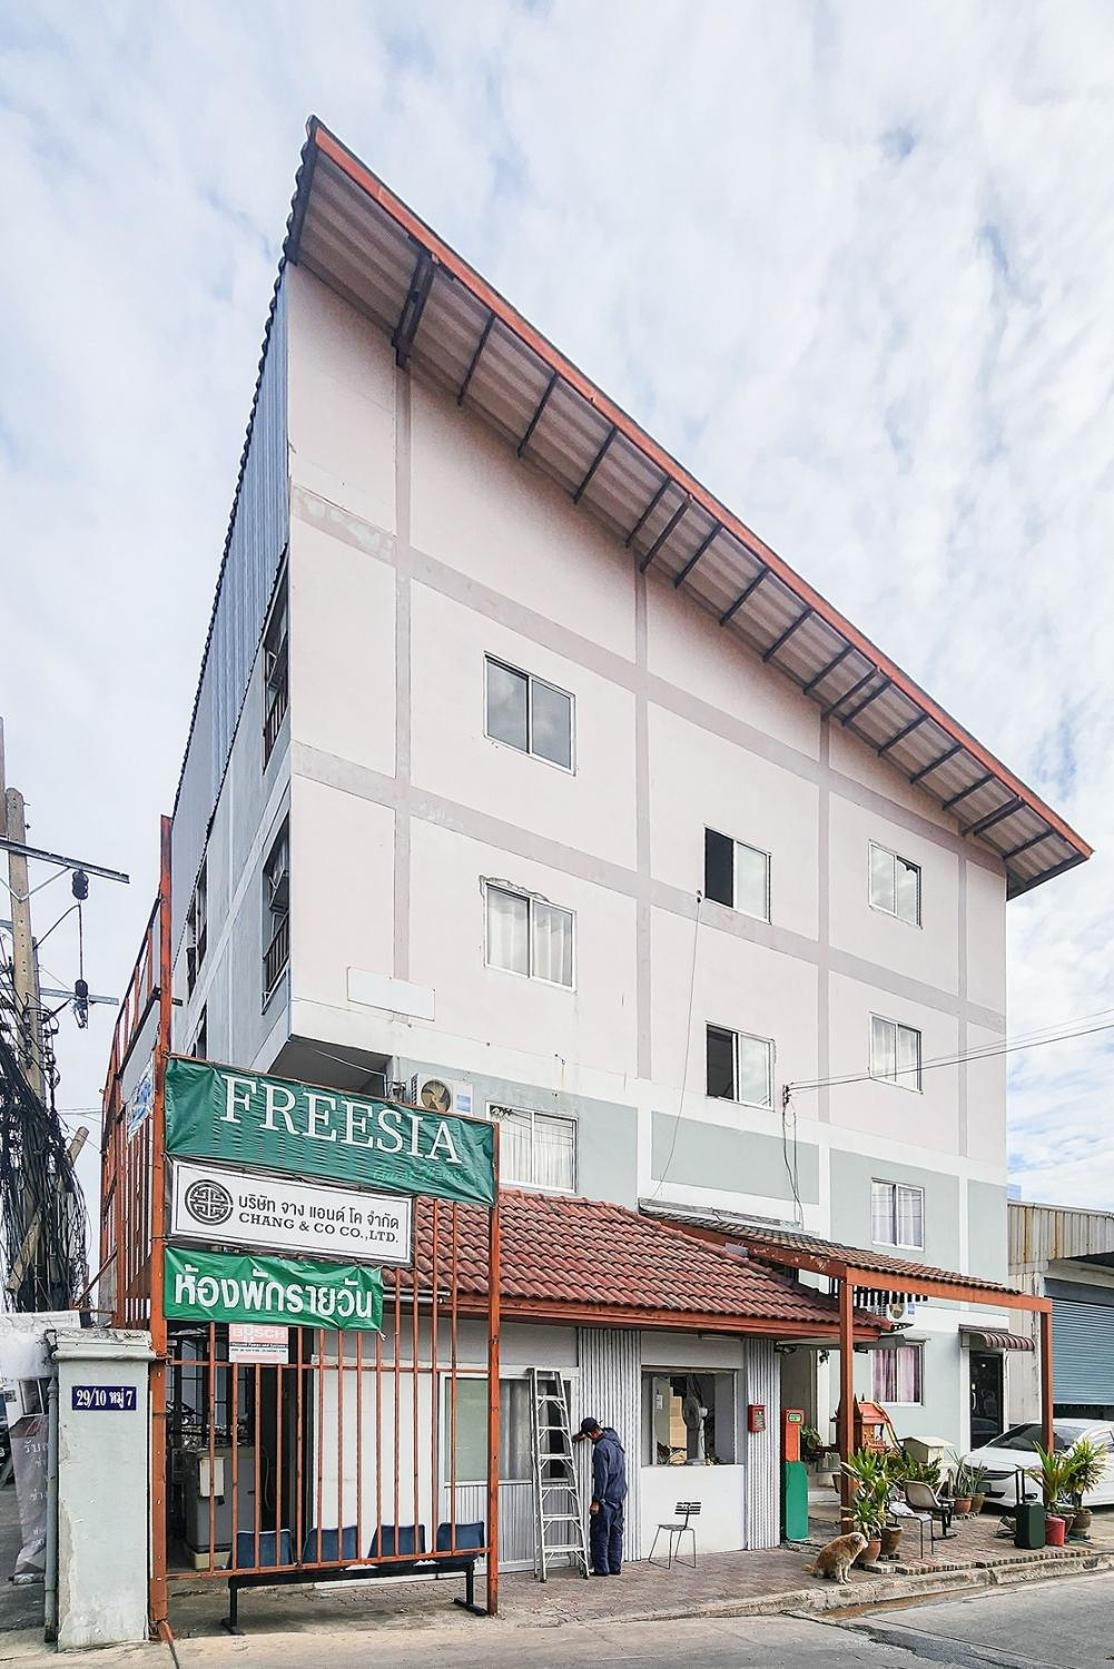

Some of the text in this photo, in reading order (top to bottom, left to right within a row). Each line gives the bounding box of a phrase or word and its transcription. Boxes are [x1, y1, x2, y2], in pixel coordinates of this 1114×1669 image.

[220, 1075, 462, 1163] FREESIA
[239, 1194, 400, 1230] บริษัท จาง แอนด์ โค จำกัด
[239, 1212, 295, 1229] CHANG
[299, 1221, 310, 1232] &
[313, 1223, 336, 1235] CO
[175, 1264, 373, 1318] ห้องพักรายวัน
[76, 1387, 107, 1408] 29/10
[125, 1390, 133, 1406] 7
